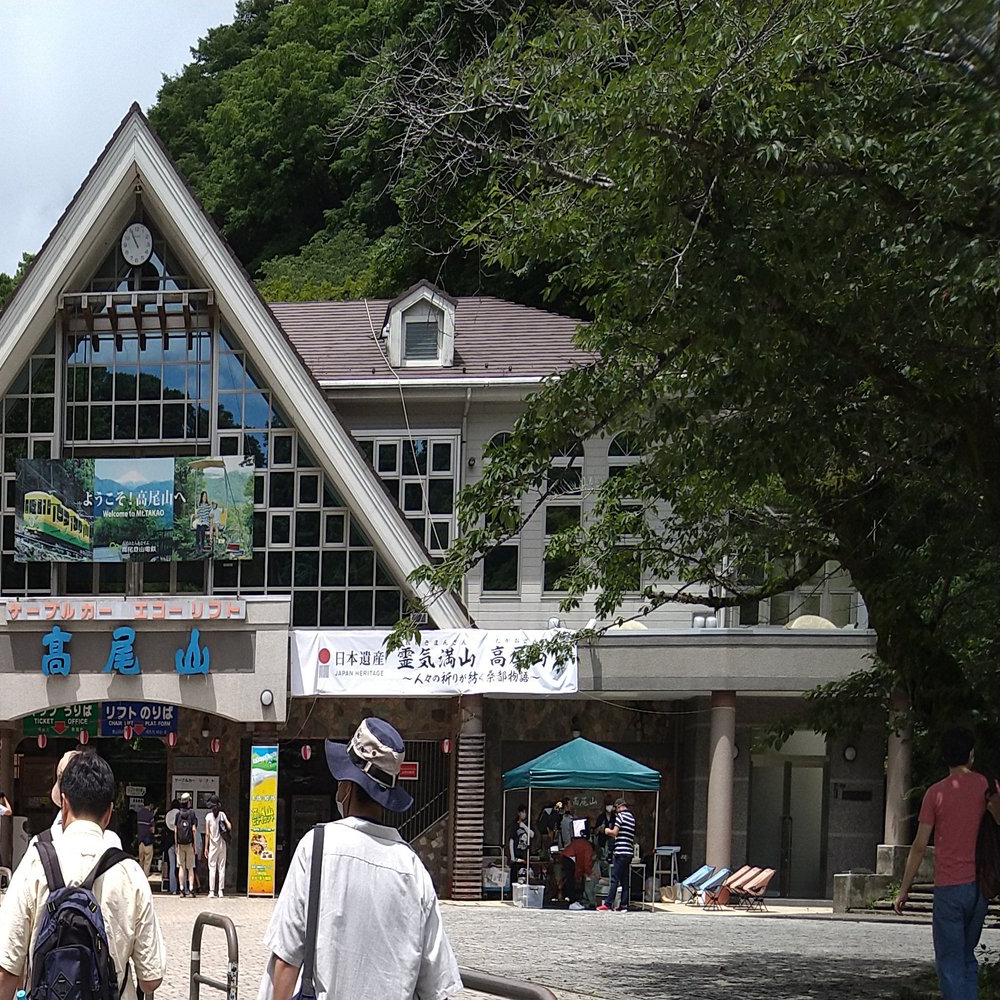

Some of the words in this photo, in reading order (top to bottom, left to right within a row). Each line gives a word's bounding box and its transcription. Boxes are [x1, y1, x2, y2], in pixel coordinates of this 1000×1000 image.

[83, 489, 186, 507] ようこそ！高尾山へ
[102, 510, 128, 518] Welcome
[129, 510, 135, 518] to
[7, 601, 112, 620] ケーブルカー
[335, 650, 385, 666] 日本遺産
[397, 647, 476, 669] 霊気満山
[106, 705, 137, 720] リフト
[140, 705, 174, 720] のりば
